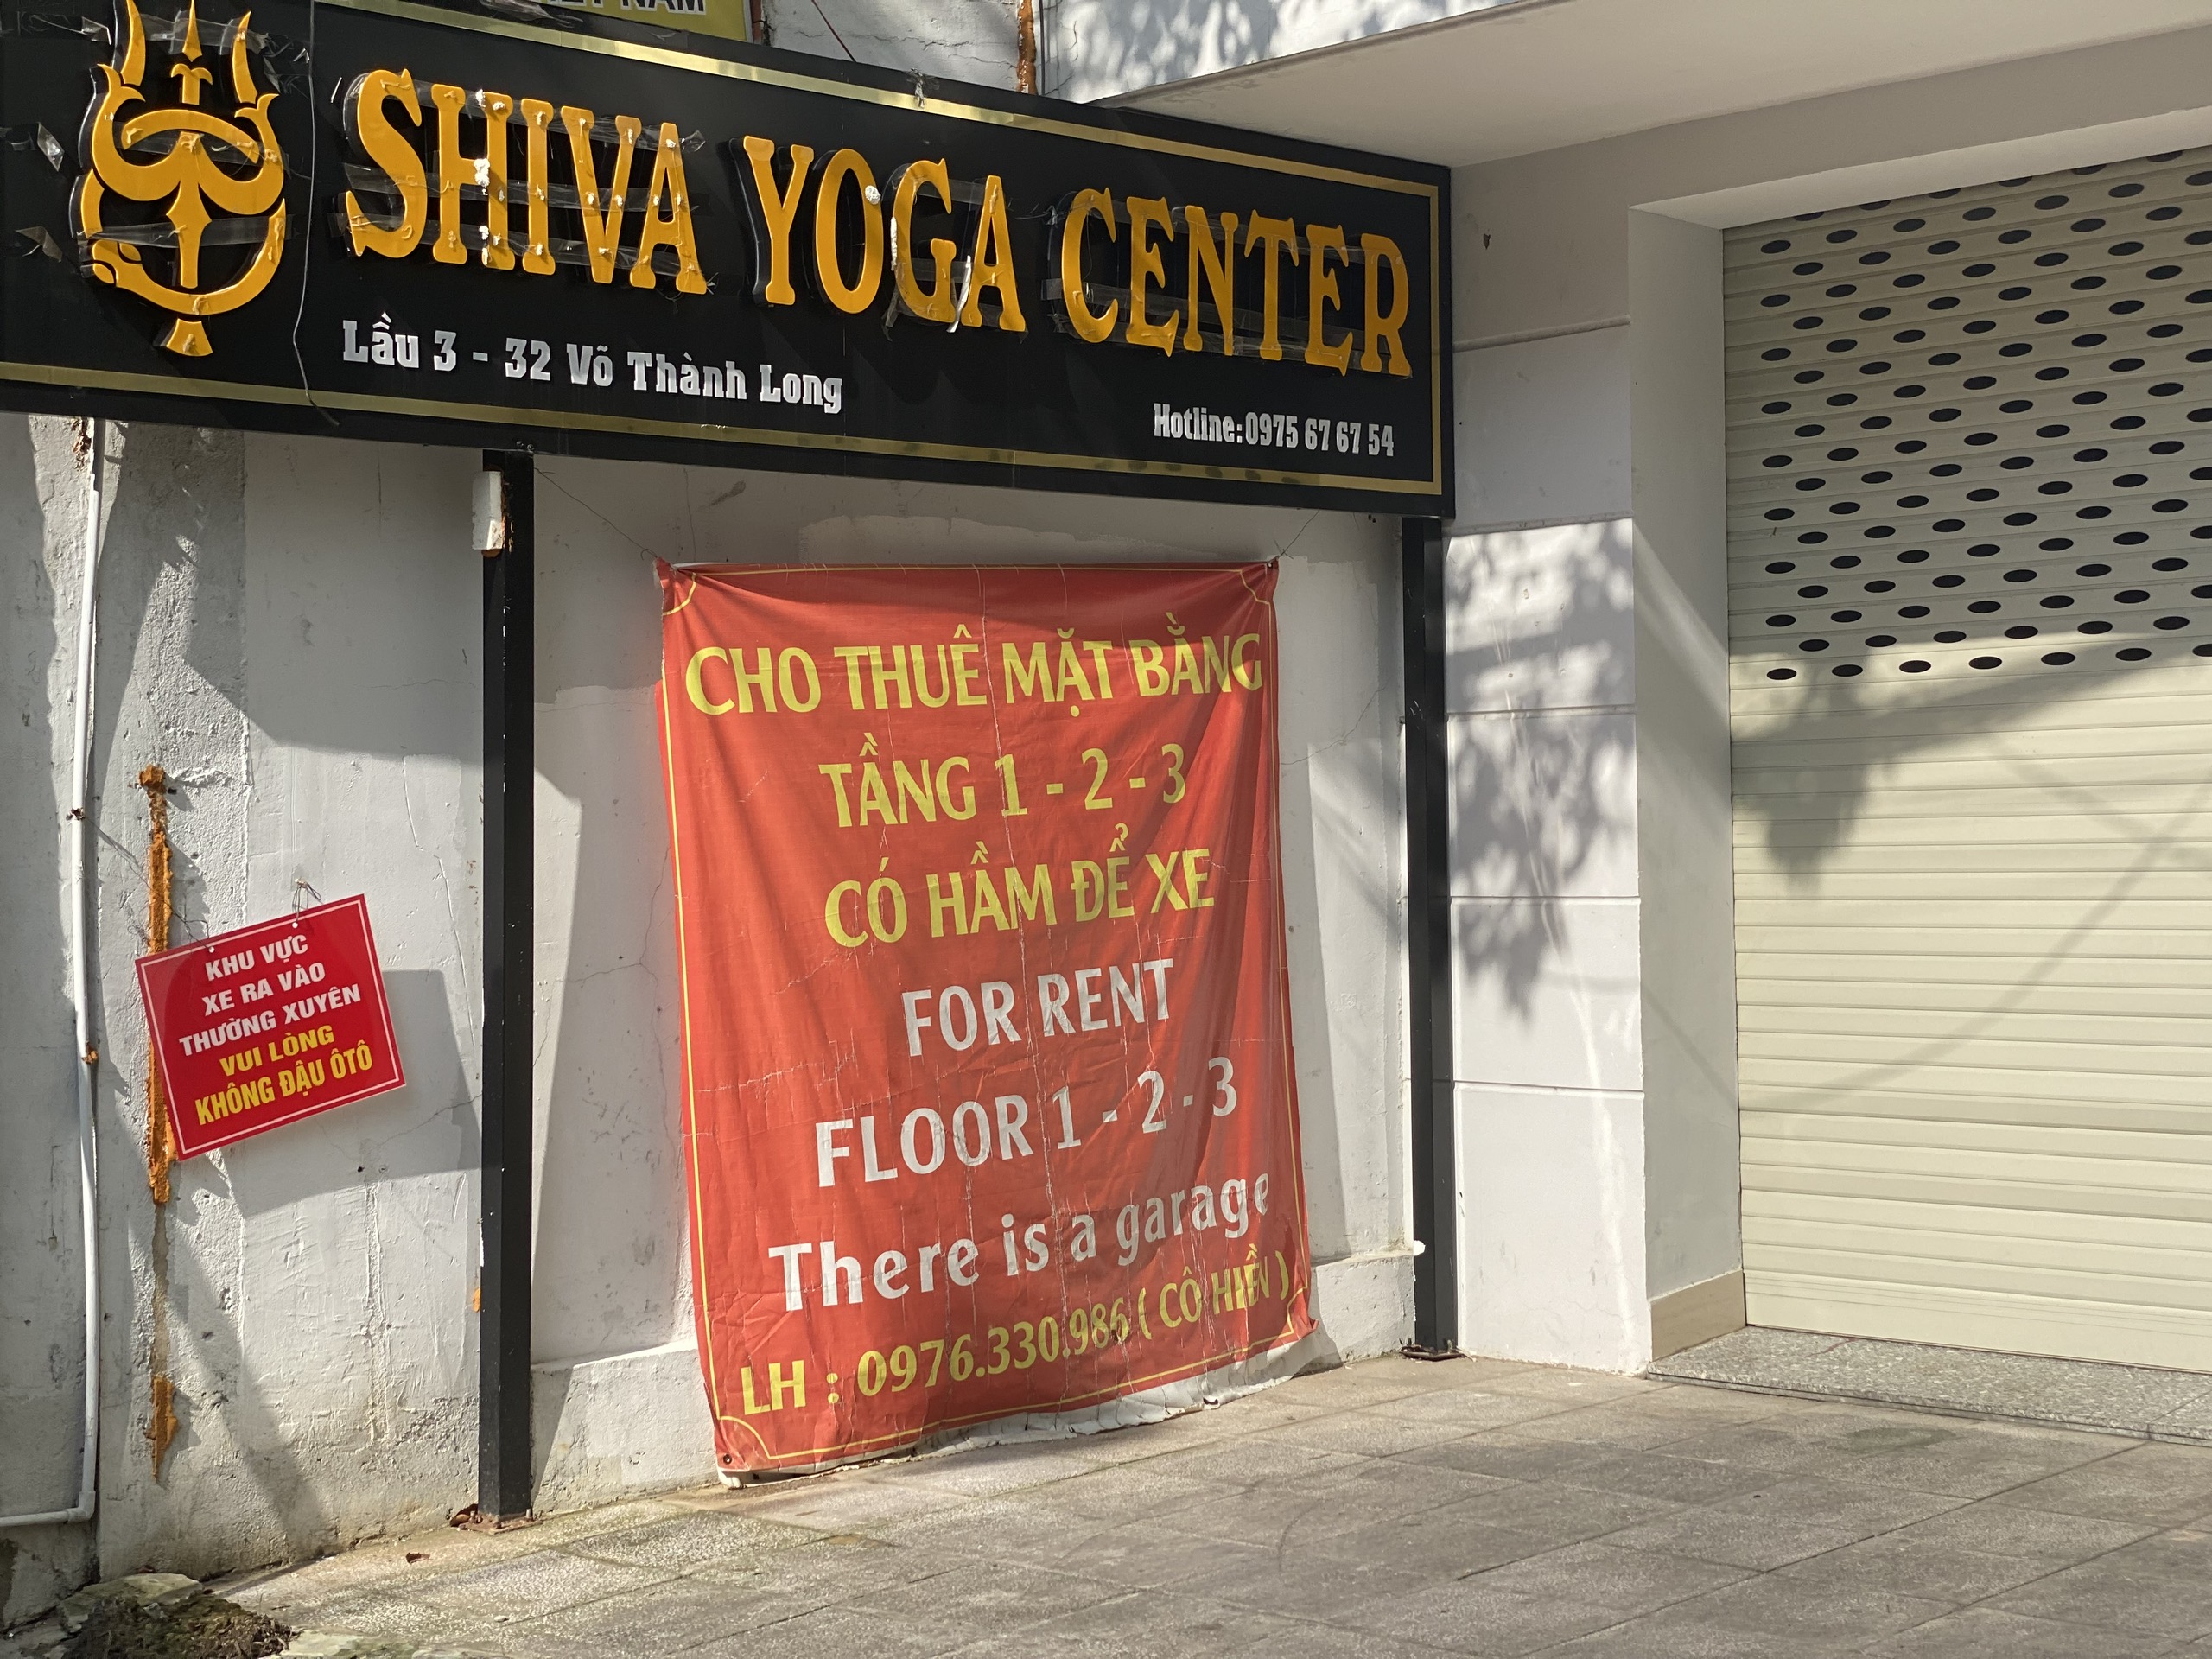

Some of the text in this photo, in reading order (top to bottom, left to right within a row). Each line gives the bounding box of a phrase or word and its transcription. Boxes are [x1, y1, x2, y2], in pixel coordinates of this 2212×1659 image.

[346, 68, 1412, 376] SHIVA YOGA CENTER
[343, 312, 419, 368] Lầu
[434, 330, 456, 372] 3
[505, 338, 551, 381] 32
[567, 343, 613, 387] Võ
[627, 351, 747, 400] Thành
[760, 364, 842, 414] Long
[1305, 418, 1330, 451] 67
[1337, 421, 1361, 454] 67
[1369, 423, 1394, 456] 54
[686, 612, 1263, 717] CHO THUÊ MẶT BẰNG
[818, 733, 976, 828] TẦNG
[995, 754, 1028, 817] 1
[1082, 747, 1113, 810] 2
[1162, 743, 1187, 804] 3
[825, 823, 1215, 949] CÓ HẦM ĐỂ XE
[201, 962, 326, 1016] XE RA VÀO
[205, 934, 308, 982] KHU VỰC
[901, 958, 1173, 1057] FOR RENT
[179, 983, 361, 1057] THƯỜNG XUYÊN
[219, 1024, 335, 1077] VUI LÒNG
[194, 1039, 373, 1126] KHÔNG ĐẬU ÔTÔ
[815, 1093, 1033, 1187] FLOOR
[1052, 1084, 1082, 1149] 1
[1136, 1070, 1167, 1134] 2
[1207, 1056, 1237, 1117] 3
[769, 1172, 1269, 1312] There is a garage
[741, 1359, 805, 1416] LH
[857, 1296, 1128, 1398] 0976.330.986
[1160, 1266, 1202, 1328] CÔ
[1211, 1243, 1269, 1315] HIỀN
